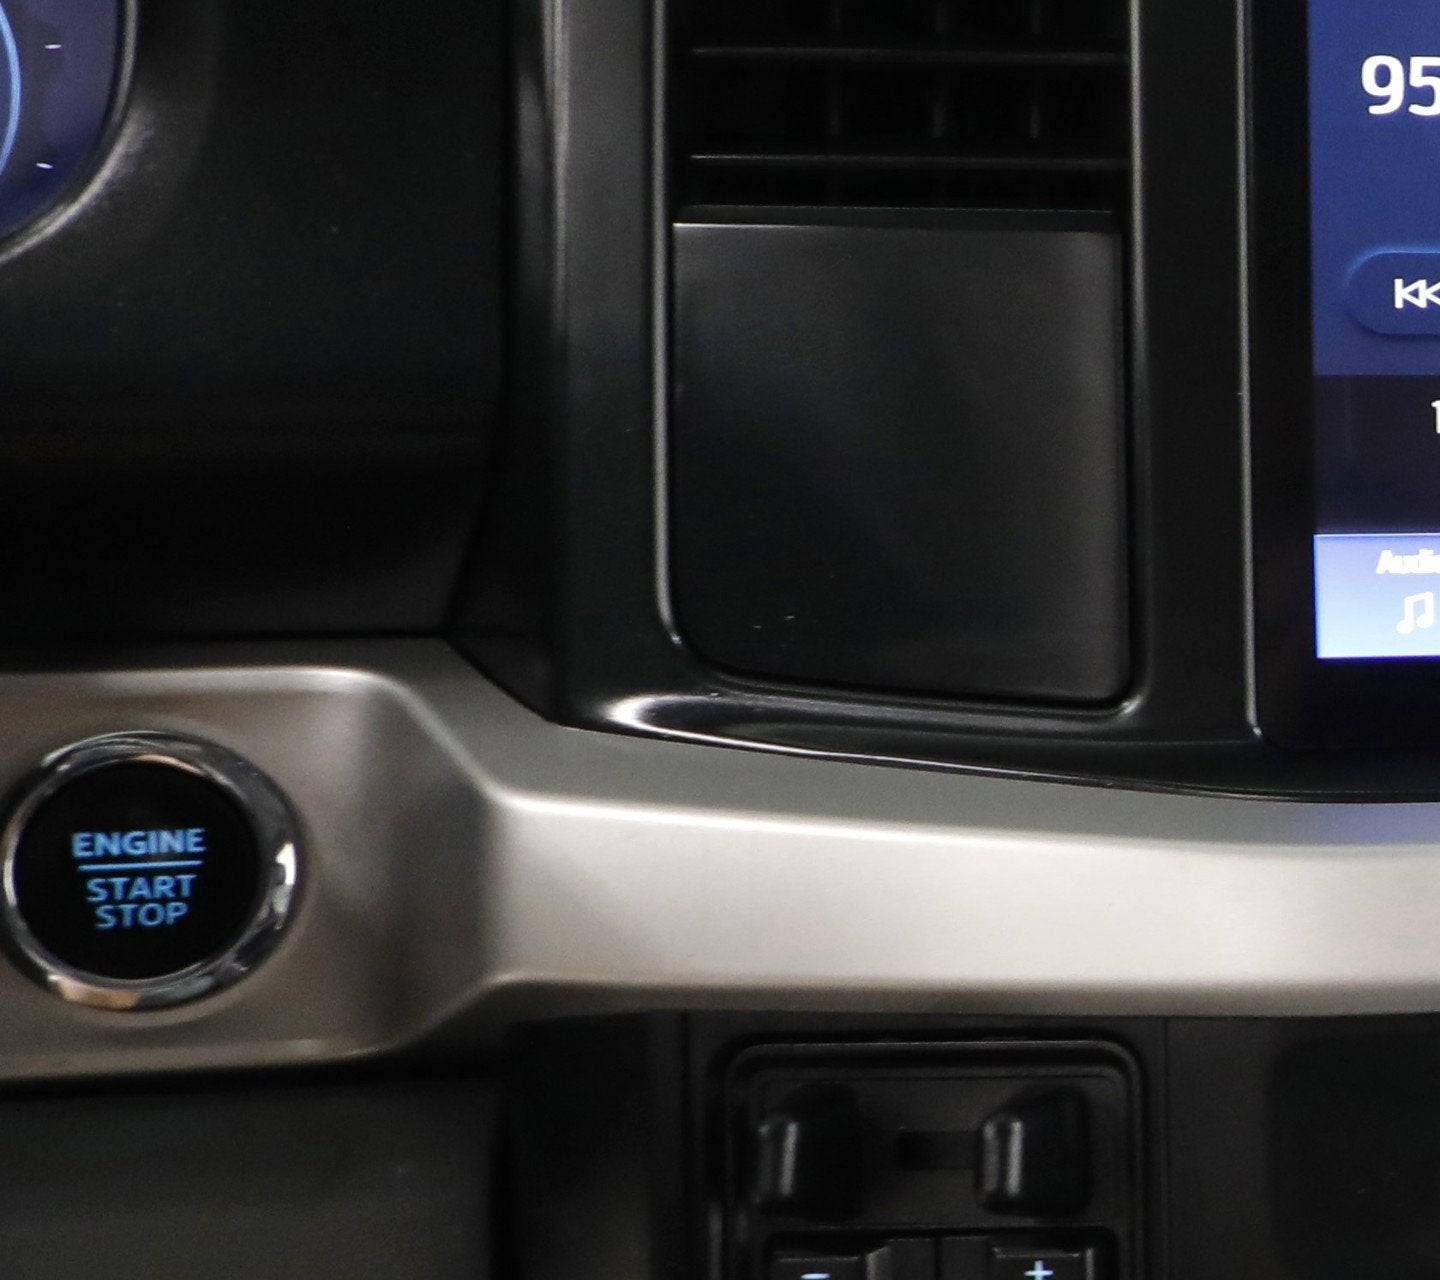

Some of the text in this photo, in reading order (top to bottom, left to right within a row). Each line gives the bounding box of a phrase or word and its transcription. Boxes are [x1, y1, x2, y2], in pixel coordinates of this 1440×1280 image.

[73, 828, 206, 858] ENGINE
[86, 874, 196, 902] START
[96, 903, 188, 928] STOP
